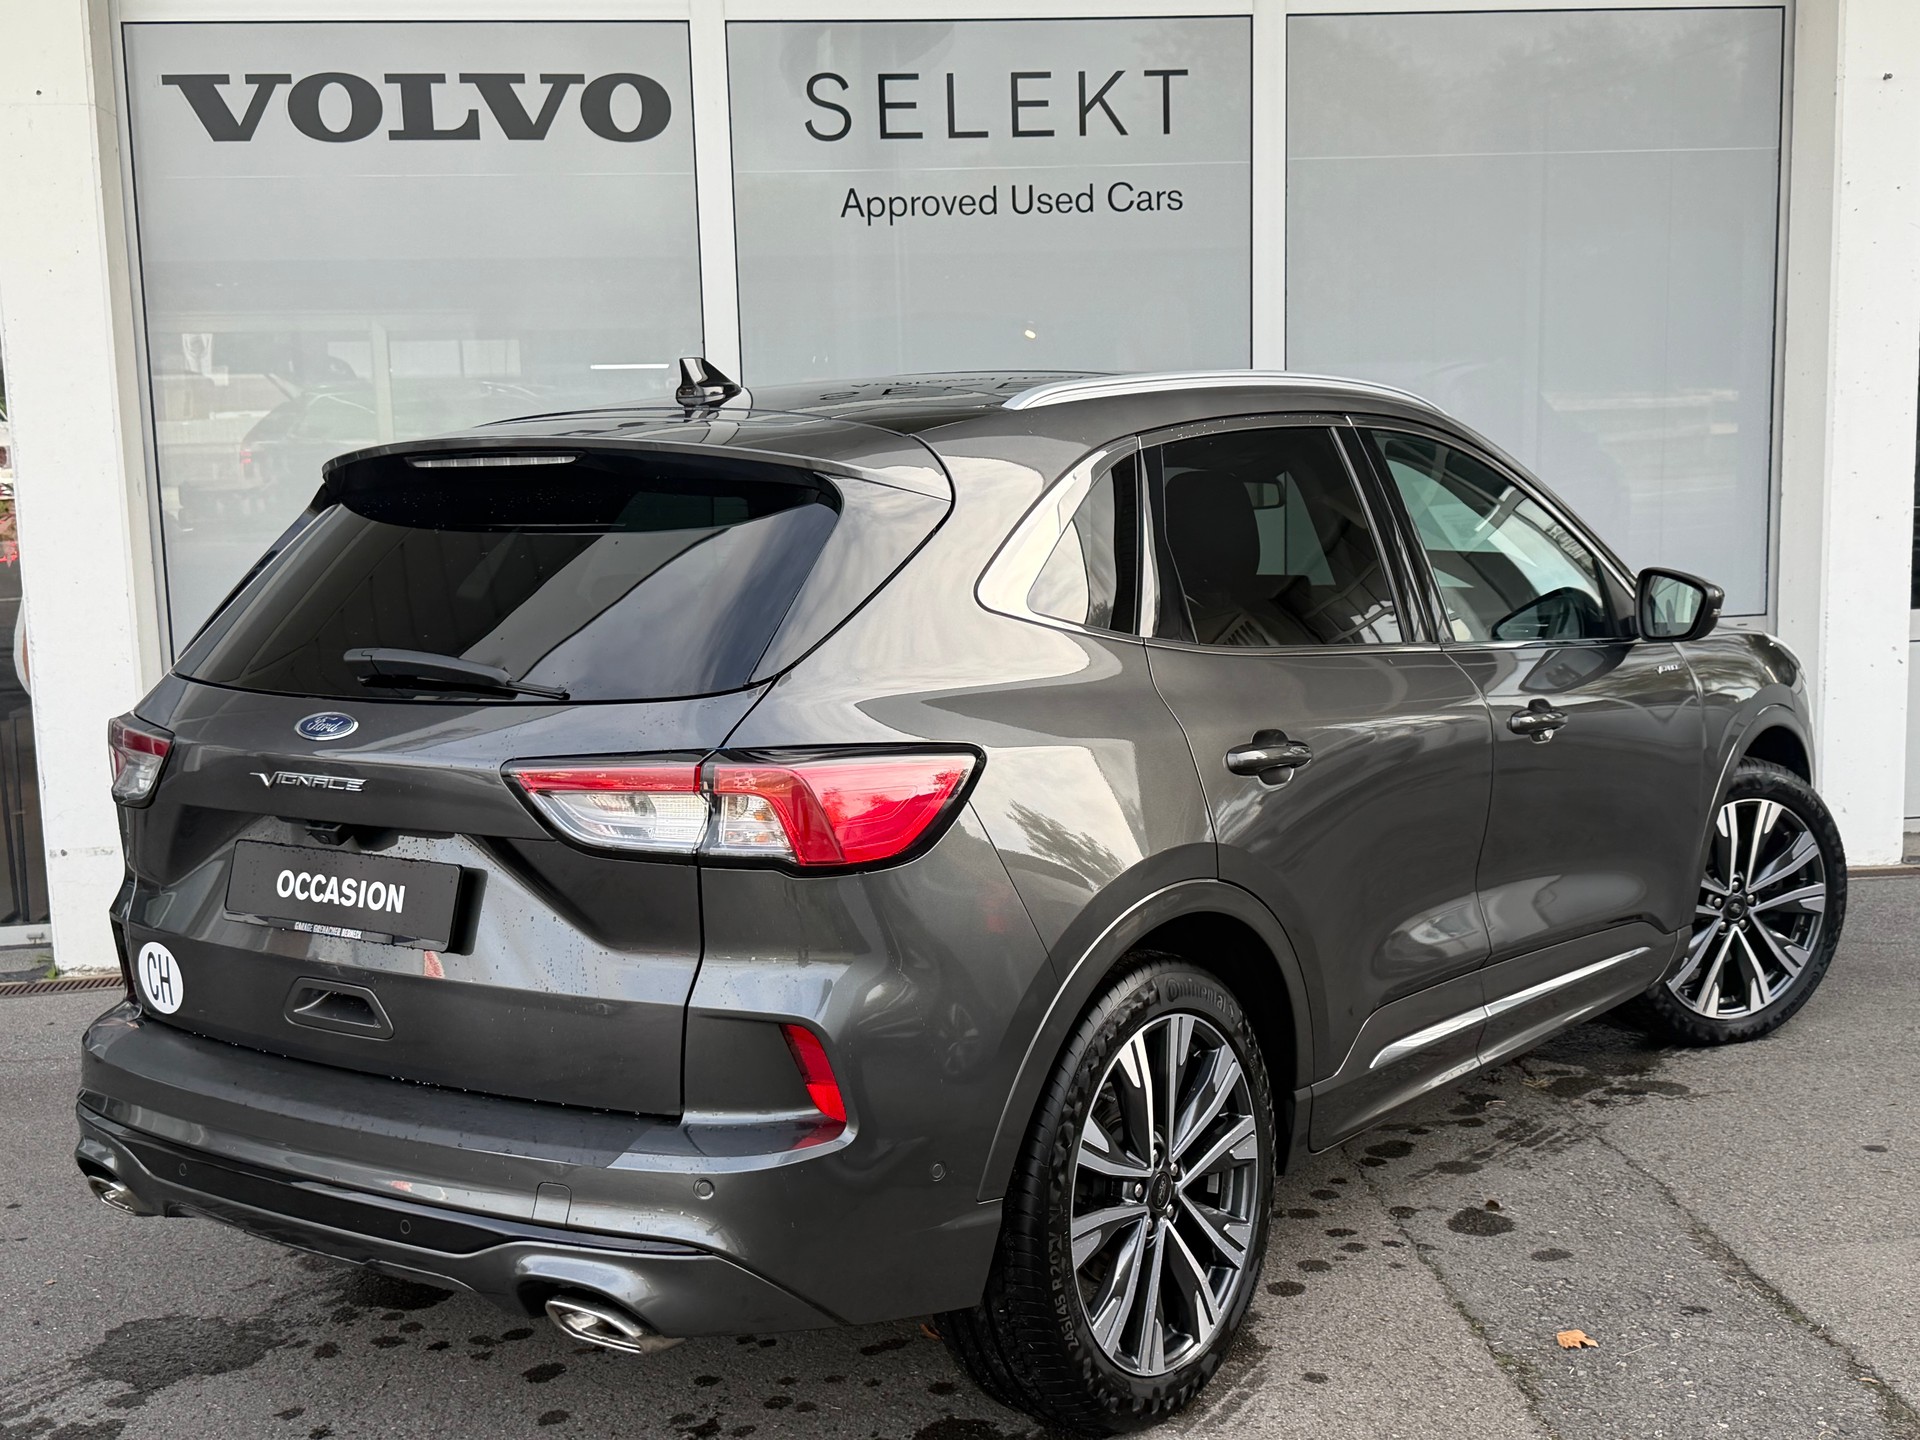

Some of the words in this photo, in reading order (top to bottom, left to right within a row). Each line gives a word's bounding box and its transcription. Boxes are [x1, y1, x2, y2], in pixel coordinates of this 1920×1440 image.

[161, 72, 672, 143] VOLVO
[804, 69, 1189, 142] SELEKT
[840, 185, 998, 226] Approved
[1011, 184, 1094, 215] Used
[1107, 181, 1184, 213] Cars
[306, 716, 344, 733] Ford
[250, 771, 369, 791] VIGNALE
[276, 869, 406, 914] OCCASION
[147, 951, 174, 1006] CH
